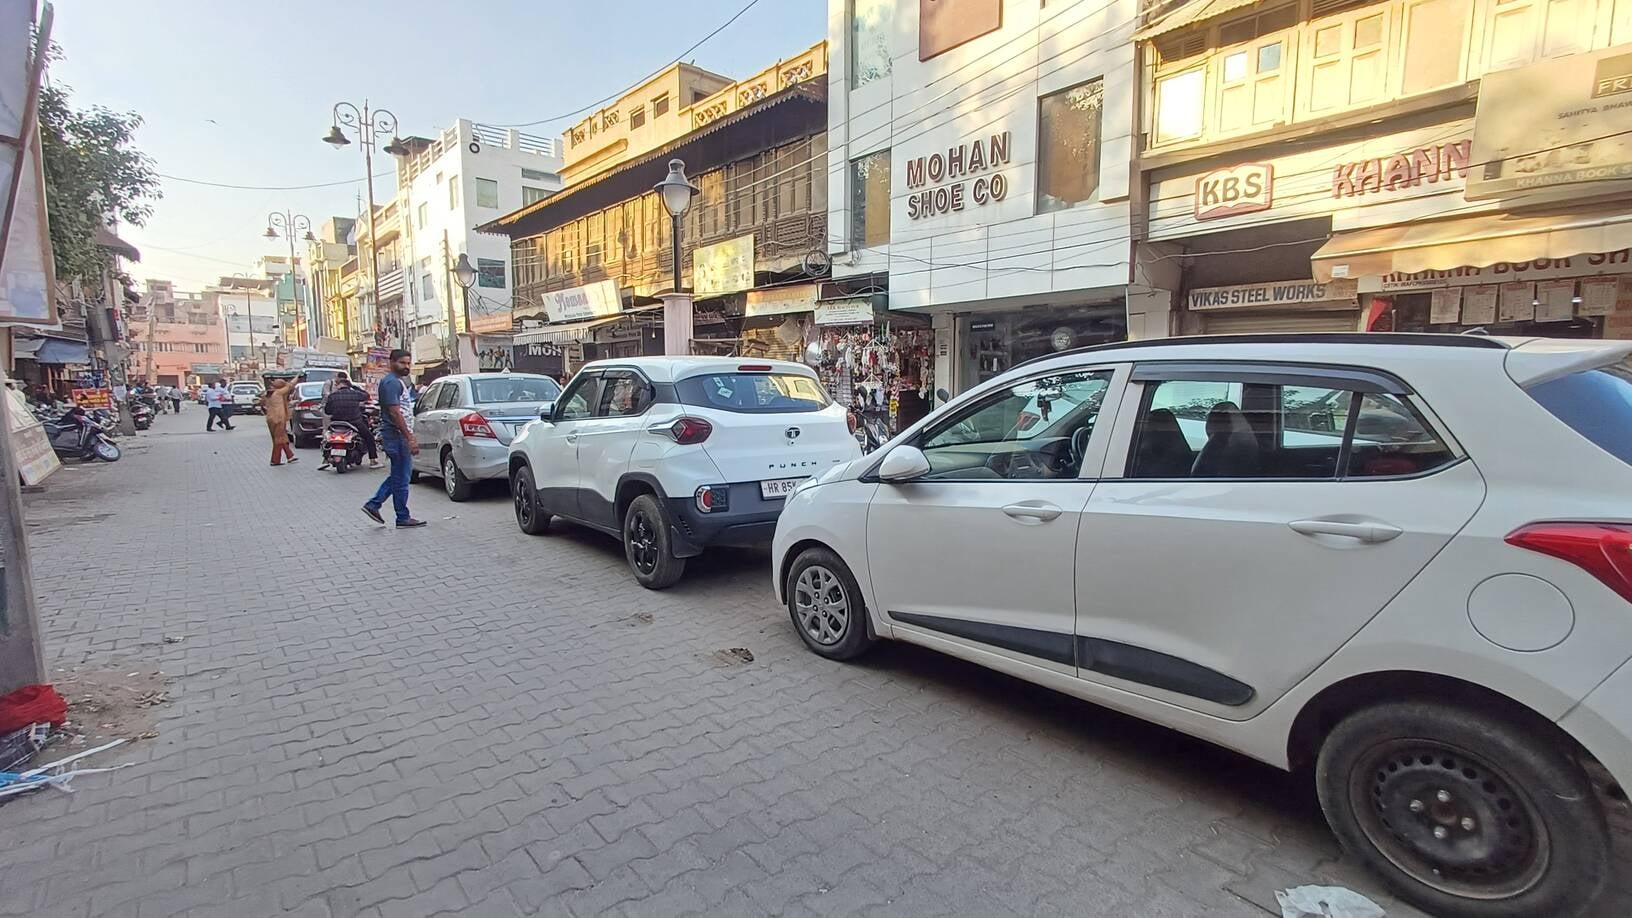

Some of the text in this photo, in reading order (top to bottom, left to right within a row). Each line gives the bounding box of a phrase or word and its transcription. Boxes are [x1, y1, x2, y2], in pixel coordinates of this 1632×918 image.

[907, 131, 1011, 188] MOHAN
[1332, 139, 1472, 199] KHANN
[1203, 173, 1262, 206] KBS
[1515, 173, 1573, 188] KHANNA
[1575, 165, 1617, 181] BOOK
[907, 174, 1008, 219] SHOE CO
[1191, 283, 1326, 308] VIKAS STEEL WORKS
[768, 461, 817, 469] PUNCH
[767, 481, 779, 494] HR
